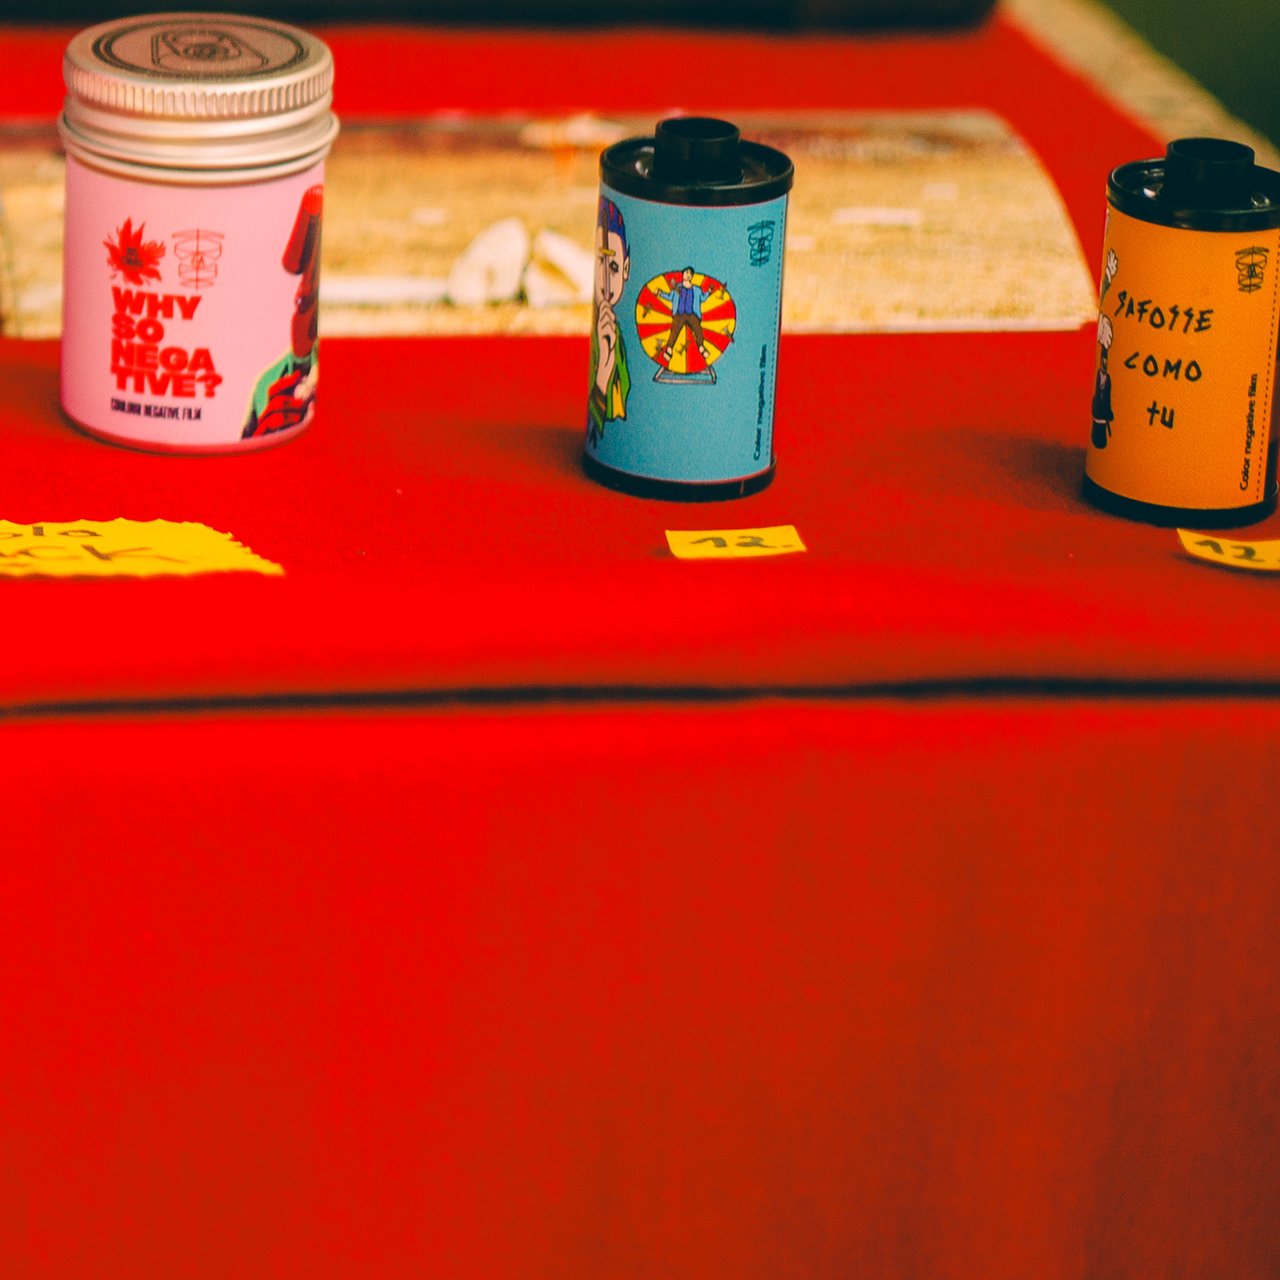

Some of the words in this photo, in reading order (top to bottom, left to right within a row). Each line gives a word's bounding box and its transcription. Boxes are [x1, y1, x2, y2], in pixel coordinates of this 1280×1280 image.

[111, 285, 202, 320] WHY
[111, 312, 164, 344] SO
[111, 338, 215, 372] NEGA
[1124, 351, 1202, 382] COMO
[110, 364, 223, 398] TIVE?
[1247, 373, 1258, 398] film
[144, 404, 180, 420] NEGATIVE
[183, 406, 201, 420] FILM
[1243, 400, 1255, 455] negative
[1239, 458, 1250, 491] Color
